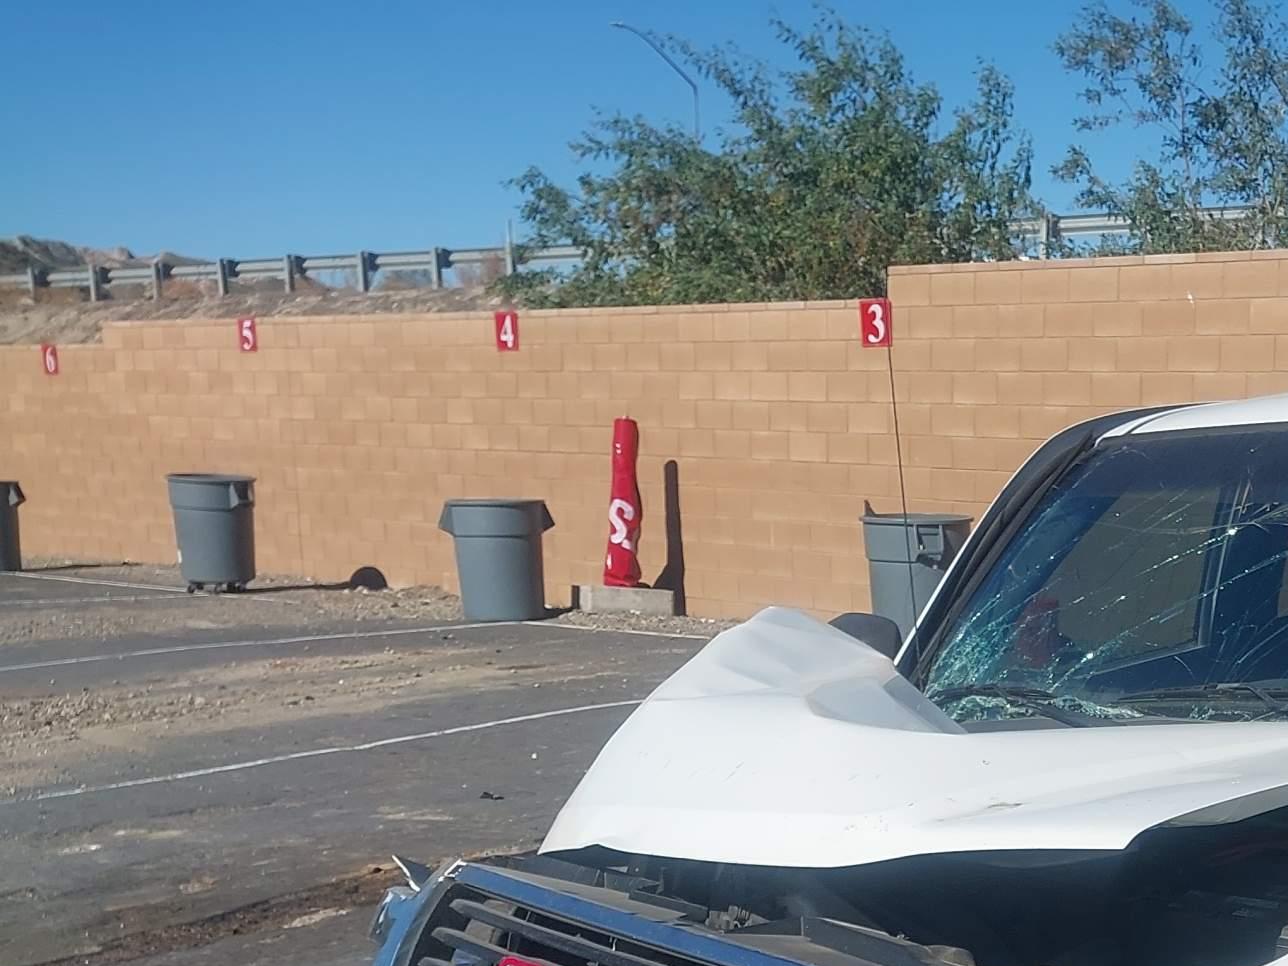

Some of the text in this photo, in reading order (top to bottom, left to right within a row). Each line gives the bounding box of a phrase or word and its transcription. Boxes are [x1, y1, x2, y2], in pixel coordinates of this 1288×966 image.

[242, 319, 253, 350] 5
[500, 314, 514, 348] 4
[867, 303, 885, 343] 3
